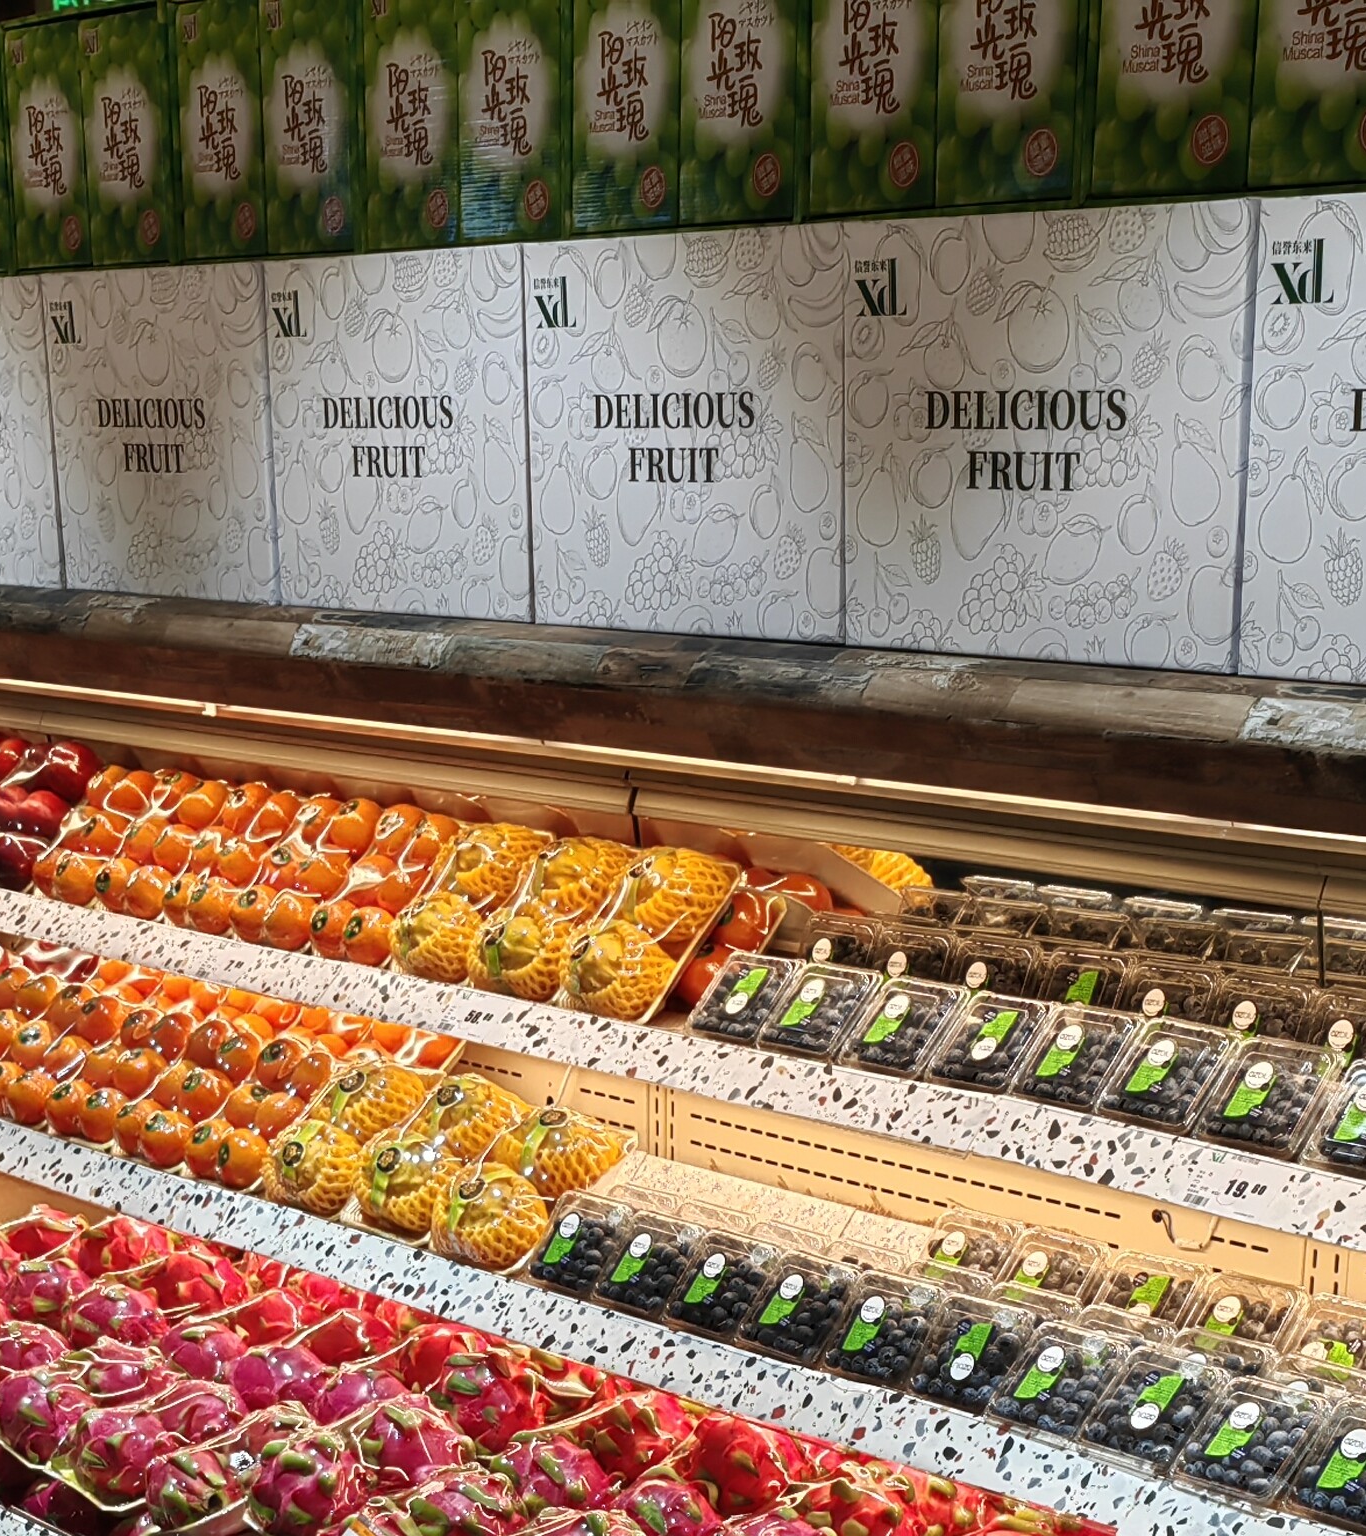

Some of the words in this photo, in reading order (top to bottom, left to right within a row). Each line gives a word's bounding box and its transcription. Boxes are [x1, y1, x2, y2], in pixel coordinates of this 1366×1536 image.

[1131, 44, 1161, 59] Shina
[1283, 46, 1325, 61] Muscat
[1292, 30, 1325, 46] Shina
[1122, 59, 1160, 74] Muscat
[1272, 240, 1313, 256] 信誉东来
[97, 398, 205, 429] DELICIOUS
[322, 396, 453, 429] DELICIOUS
[593, 391, 756, 429] DELICIOUS
[924, 389, 1127, 431] DELICIOUS
[122, 442, 184, 474] FRUIT
[351, 445, 426, 478] FRUIT
[628, 447, 719, 483] FRUIT
[966, 450, 1081, 491] FRUIT
